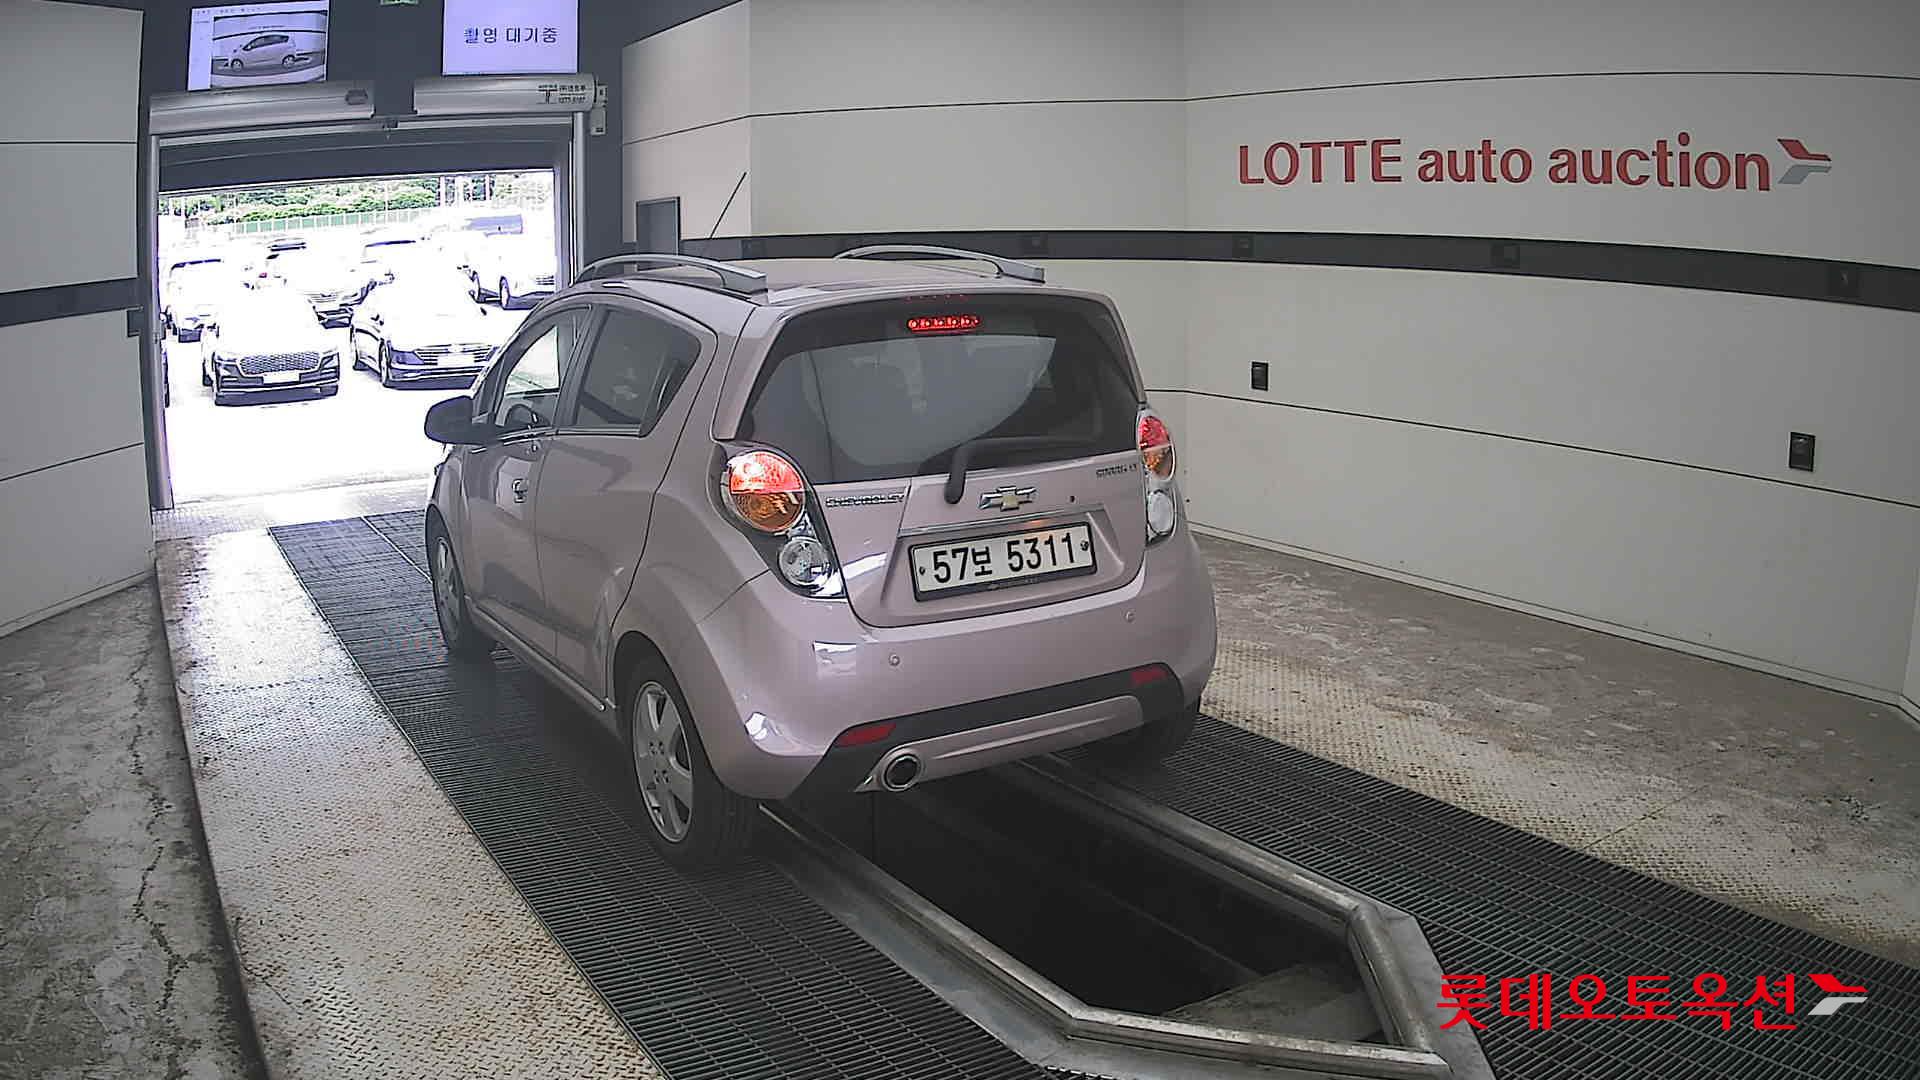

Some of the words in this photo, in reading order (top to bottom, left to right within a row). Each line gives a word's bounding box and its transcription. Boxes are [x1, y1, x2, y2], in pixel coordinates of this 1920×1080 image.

[506, 27, 558, 44] 대기중
[1239, 138, 1401, 185] LOTTE
[1417, 139, 1533, 184] auto
[1549, 131, 1770, 191] auction
[932, 545, 993, 584] 57보
[1006, 532, 1075, 573] 5311
